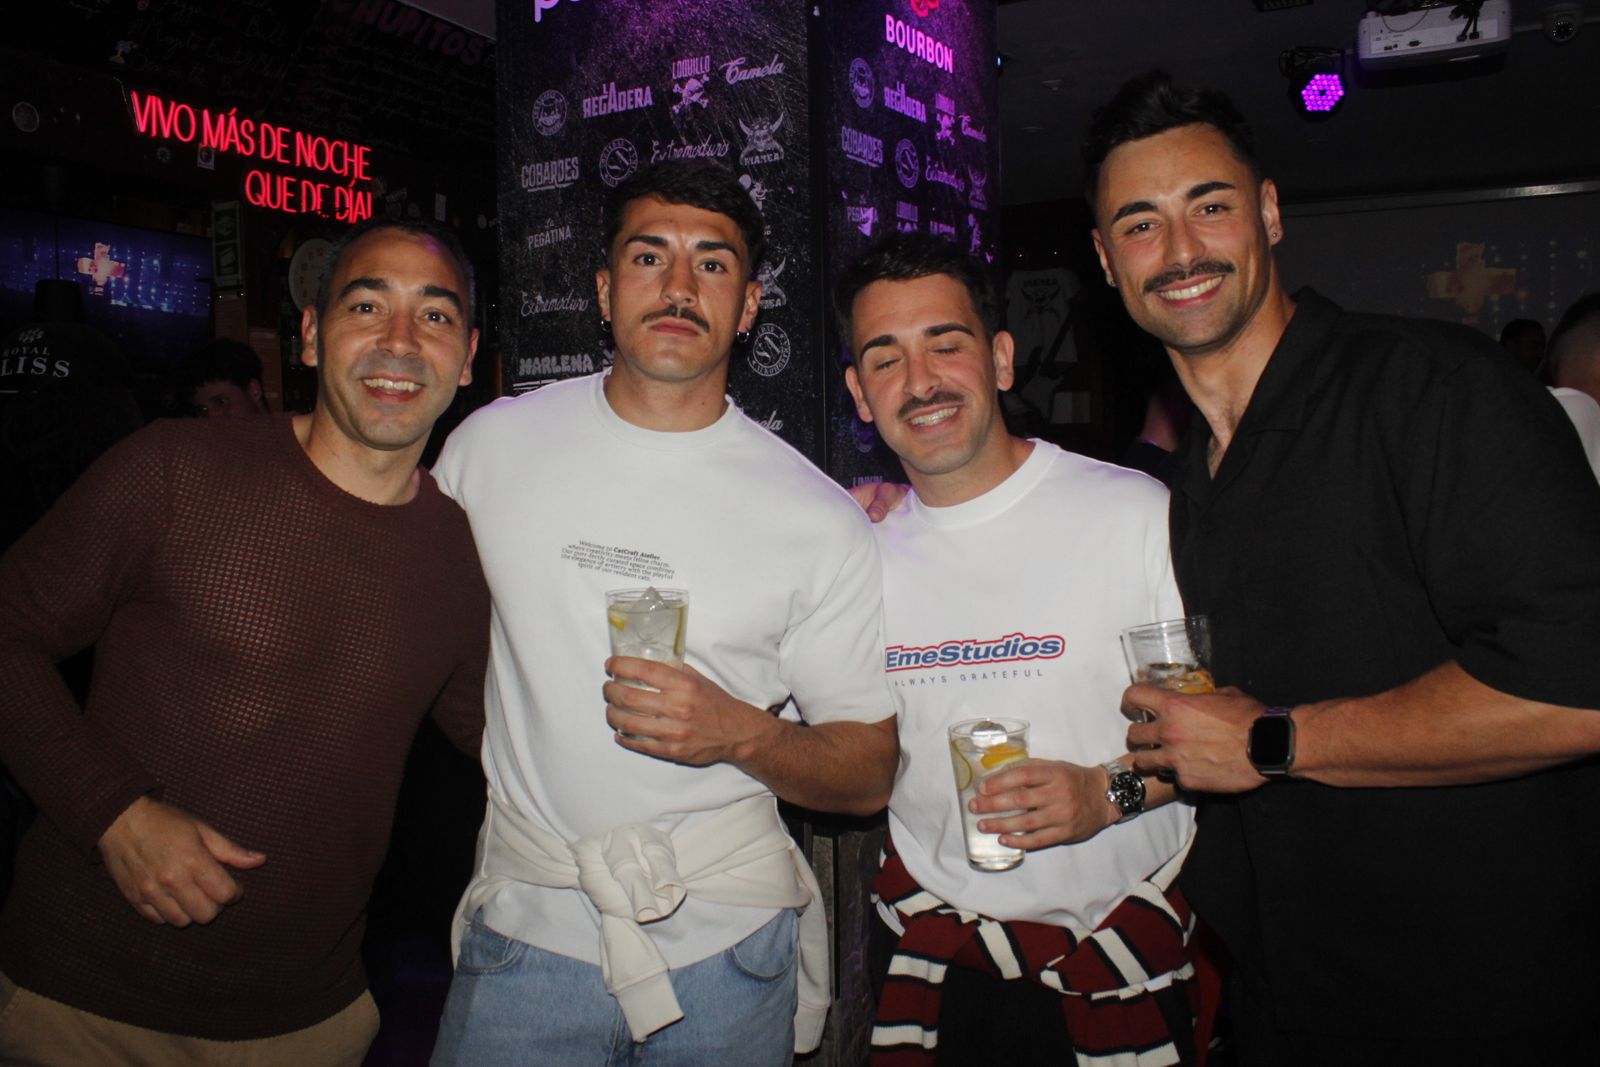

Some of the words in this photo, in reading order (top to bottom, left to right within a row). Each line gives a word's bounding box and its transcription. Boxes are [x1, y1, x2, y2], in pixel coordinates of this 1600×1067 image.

[885, 13, 954, 74] BOURBON
[719, 53, 785, 85] Camela
[131, 89, 196, 142] VIVO
[201, 107, 255, 156] MÁS
[261, 123, 291, 164] DE
[295, 131, 372, 181] NOCHE
[521, 156, 580, 192] COBARDES
[245, 170, 297, 213] QUE
[301, 180, 330, 218] DE
[528, 225, 572, 249] PEGATINA
[0, 356, 71, 379] LISS
[519, 353, 594, 376] MARLENA
[579, 540, 605, 550] Welcome
[613, 547, 639, 556] CatCraft
[885, 634, 1063, 671] EmeStudios
[959, 668, 1044, 682] GRATEFUL
